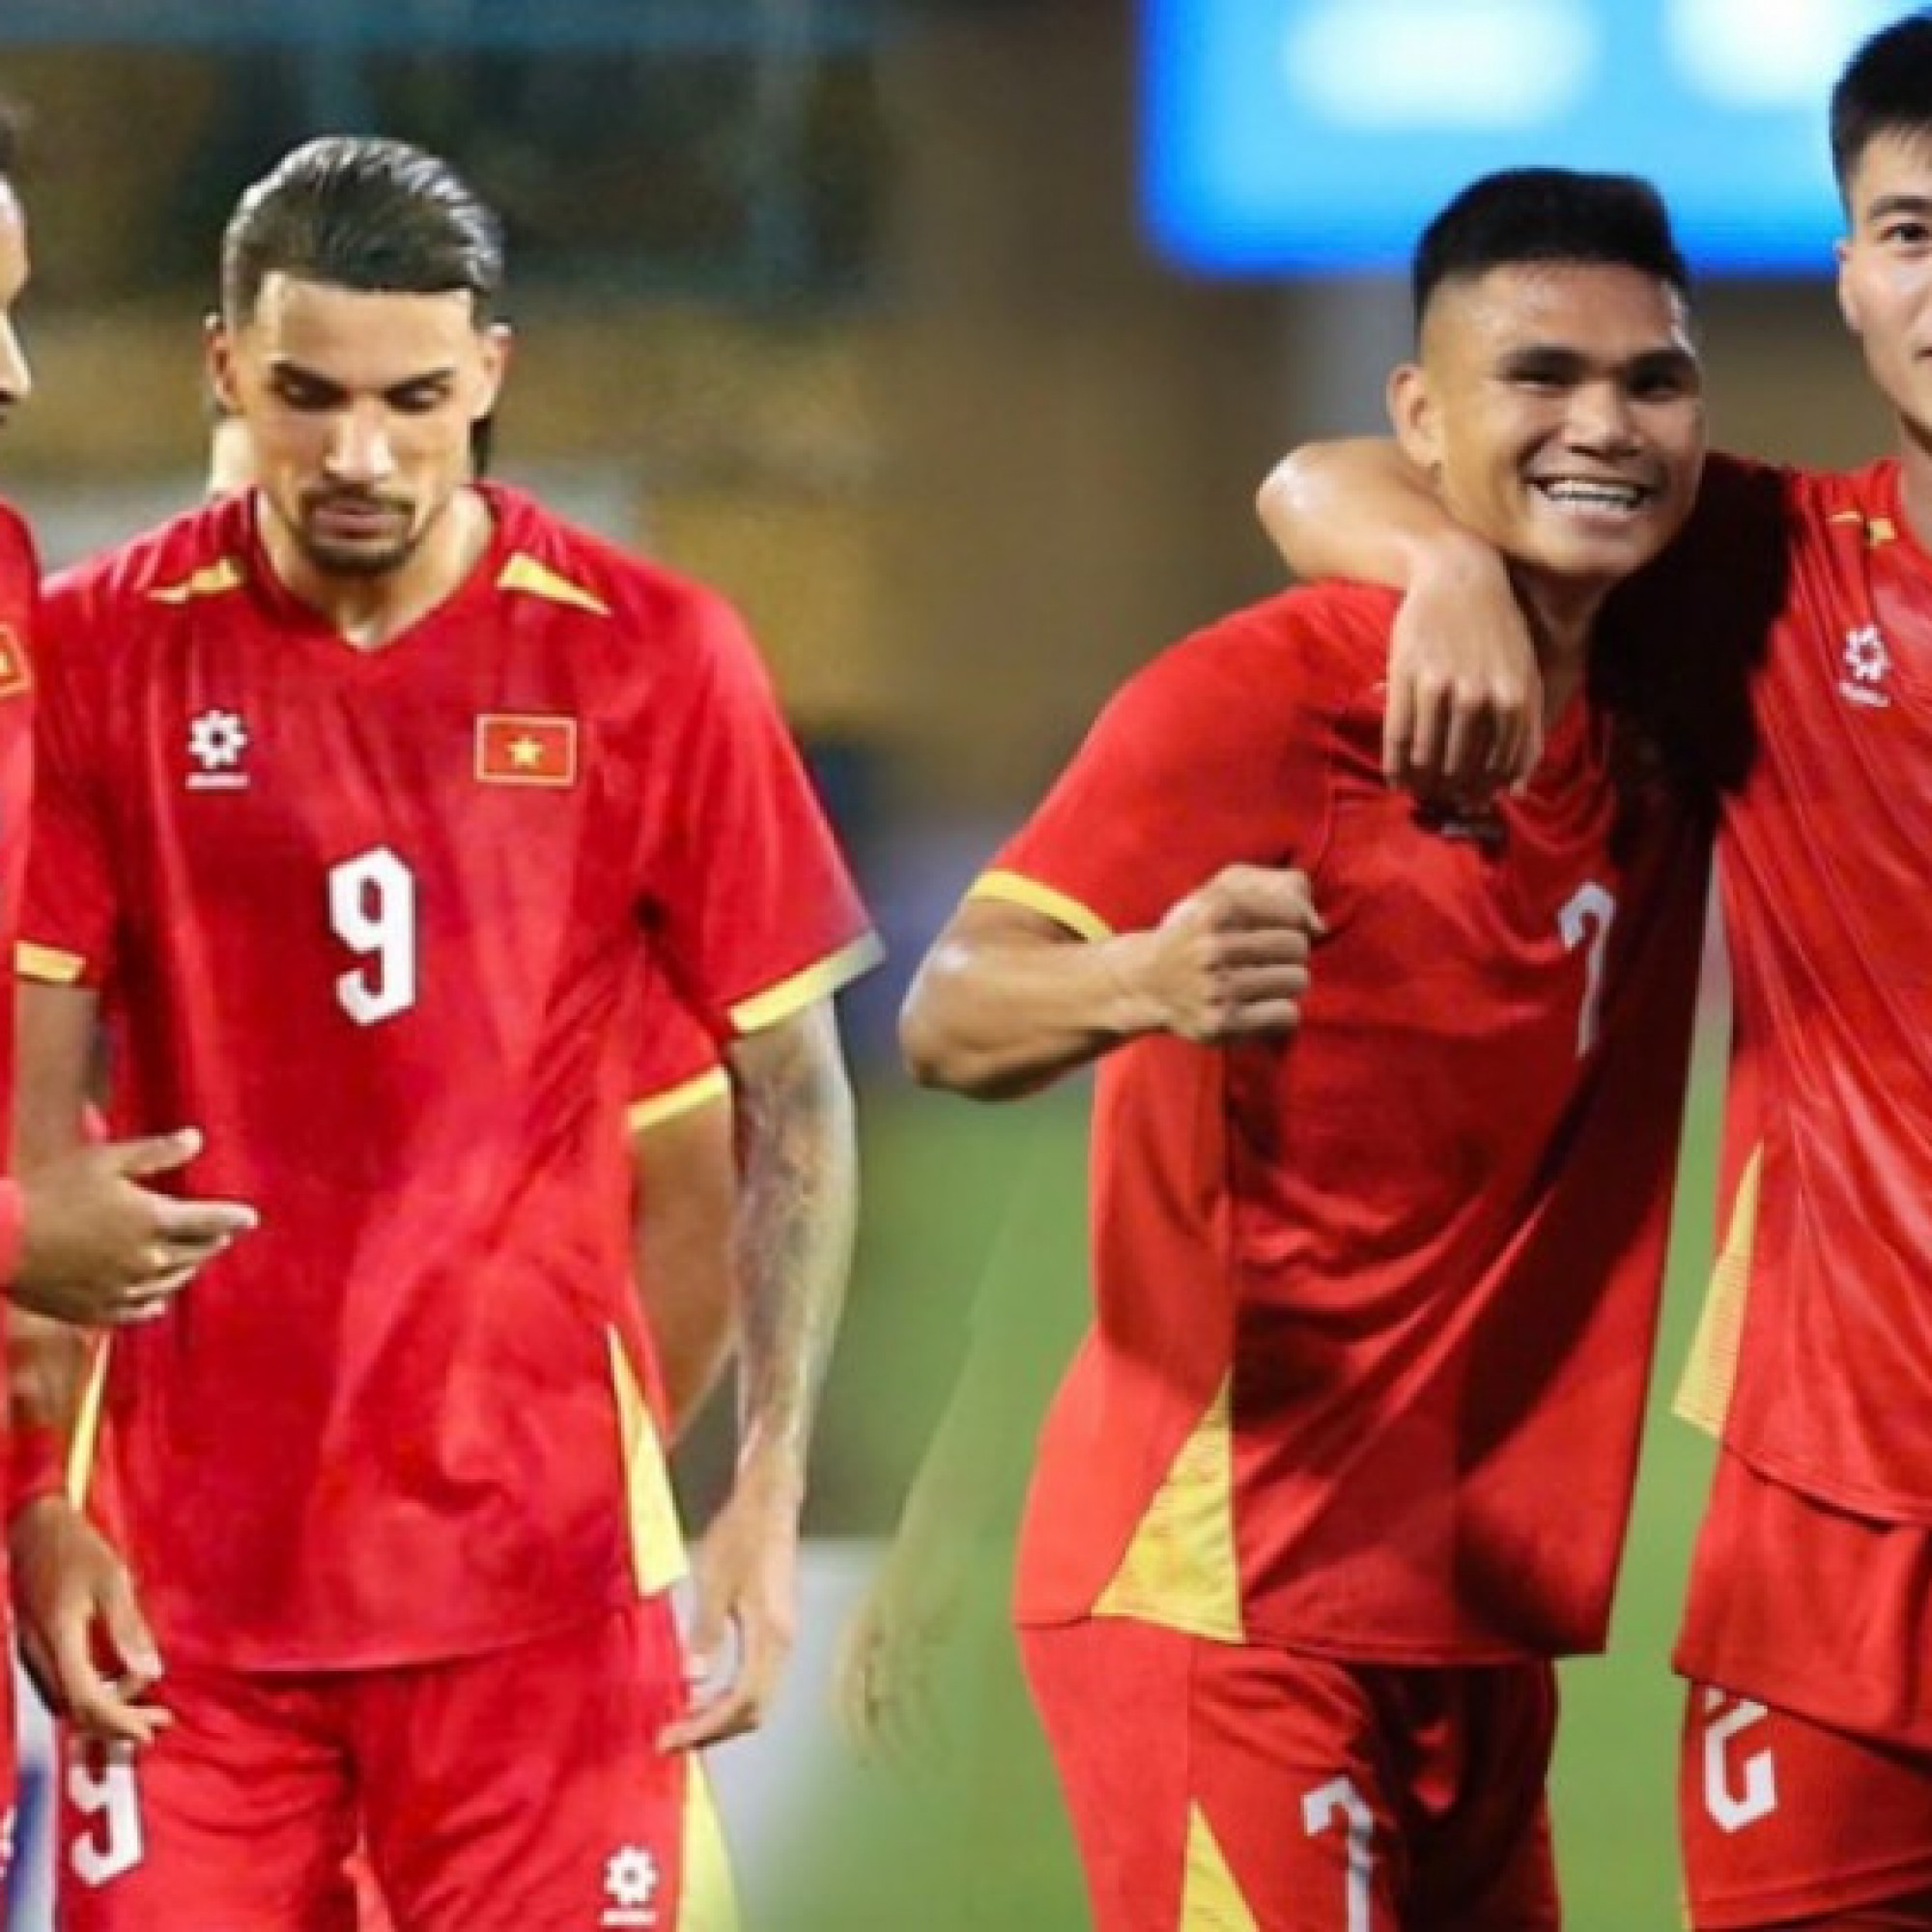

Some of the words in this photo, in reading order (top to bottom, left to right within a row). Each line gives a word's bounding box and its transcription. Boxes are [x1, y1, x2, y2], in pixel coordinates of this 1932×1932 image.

[328, 845, 415, 1025] 9
[1557, 880, 1617, 1059] 7
[68, 1738, 144, 1887] 9
[1300, 1776, 1375, 1932] 7
